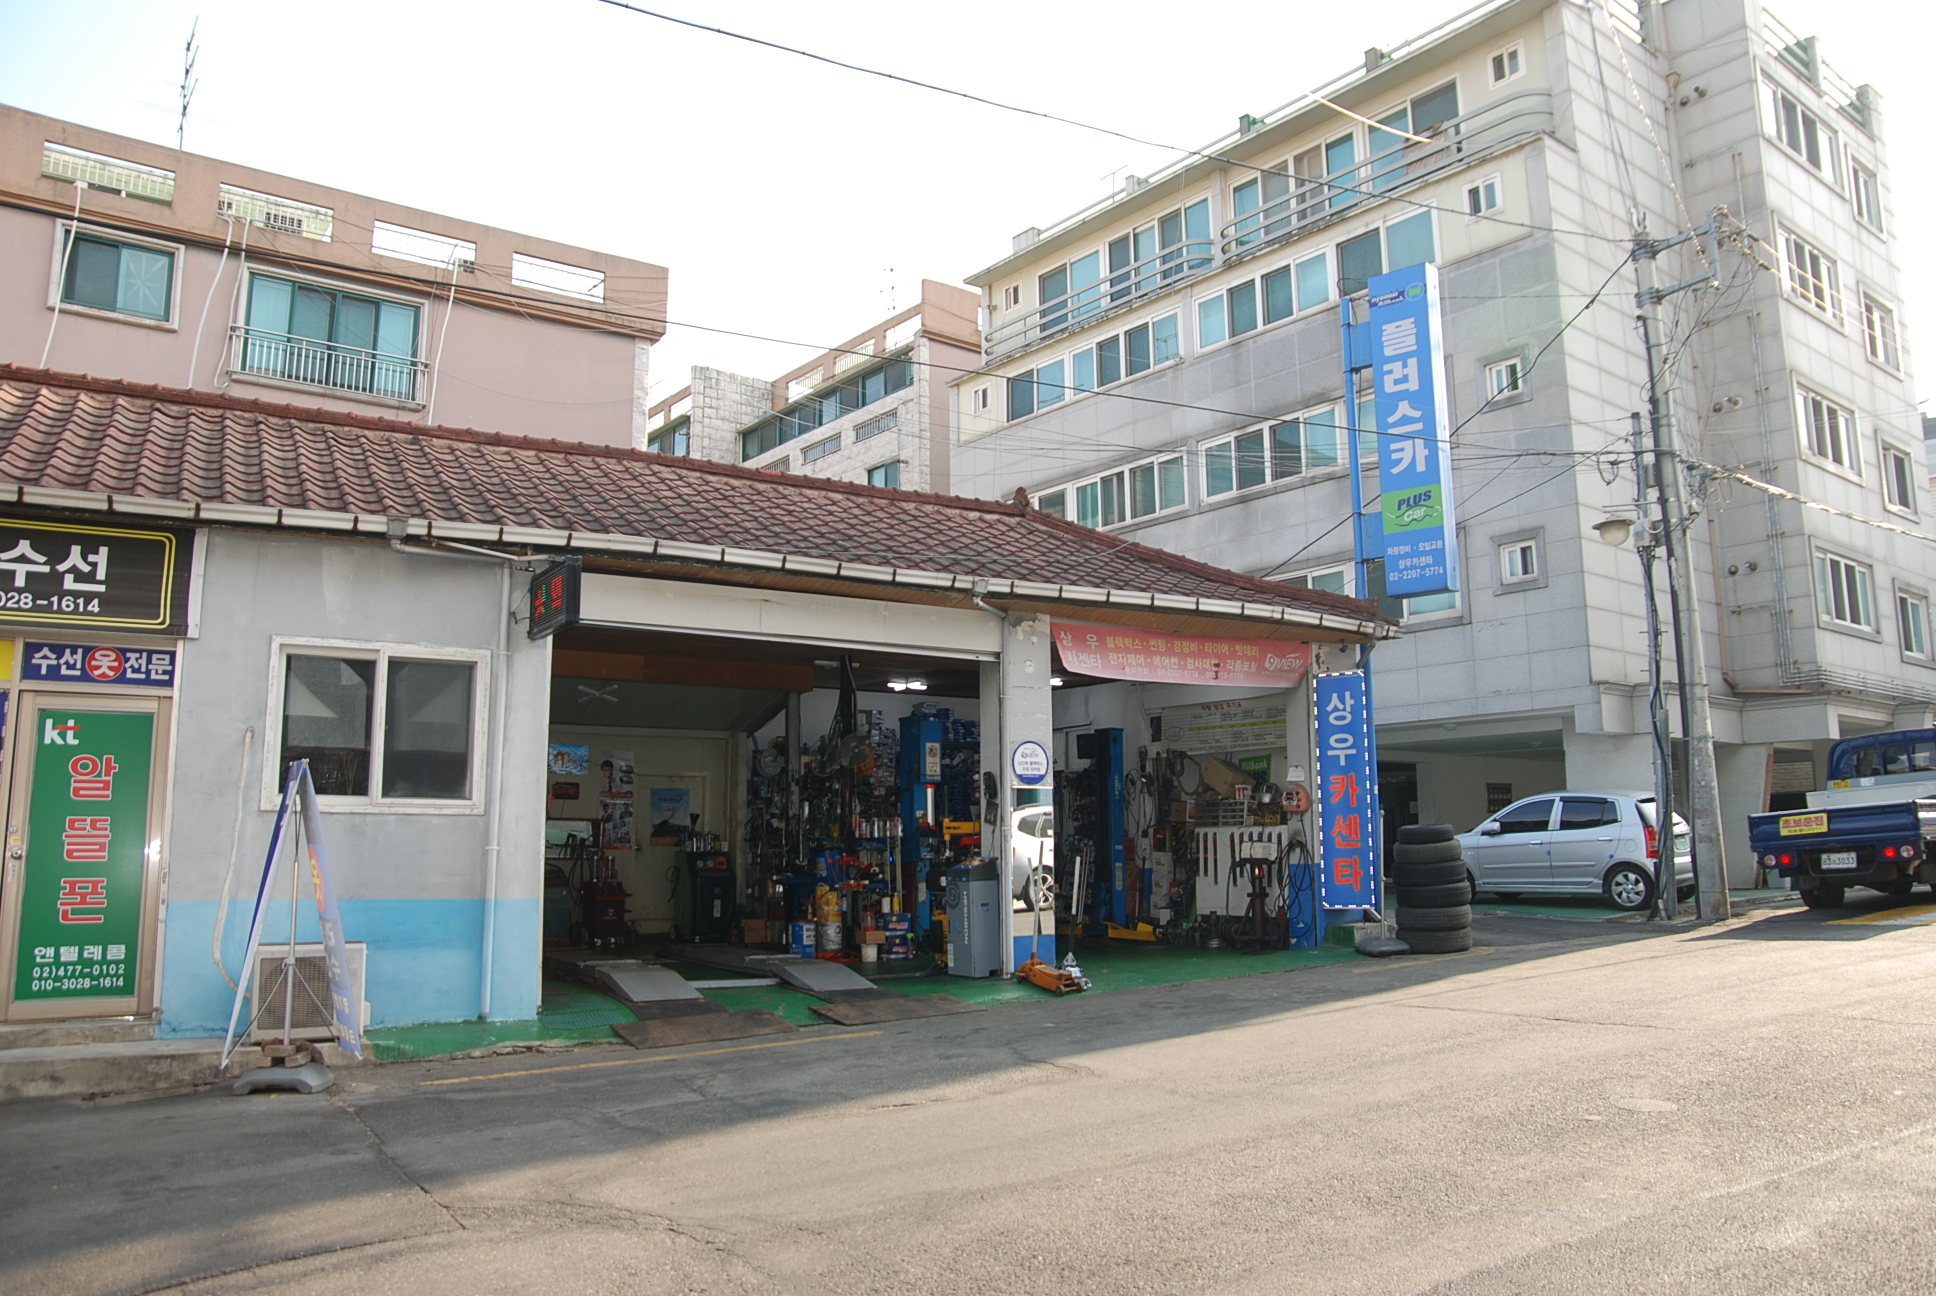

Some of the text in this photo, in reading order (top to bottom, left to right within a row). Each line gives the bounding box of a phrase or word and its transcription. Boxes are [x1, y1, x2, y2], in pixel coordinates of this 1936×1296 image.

[1381, 316, 1429, 475] 플러스카
[1397, 490, 1432, 511] PLUS
[1403, 507, 1427, 522] Car
[0, 539, 109, 593] 수선
[1398, 555, 1433, 569] 상우카센타
[1389, 566, 1444, 581] 02-2207-5774
[1106, 636, 1142, 649] 블랙박스
[1173, 640, 1198, 653] 경정비
[1204, 642, 1229, 655] 타이어
[1065, 650, 1102, 669] 카센타
[1108, 652, 1145, 666] 전자제어
[1153, 656, 1178, 668] 에어컨
[43, 718, 81, 745] kt
[1241, 759, 1268, 771] Oilbank
[1782, 816, 1824, 829] 초보운전
[58, 754, 119, 924] 알뜰폰
[32, 964, 125, 978] 02)477-0102
[31, 976, 125, 992] 010-3028-1614
